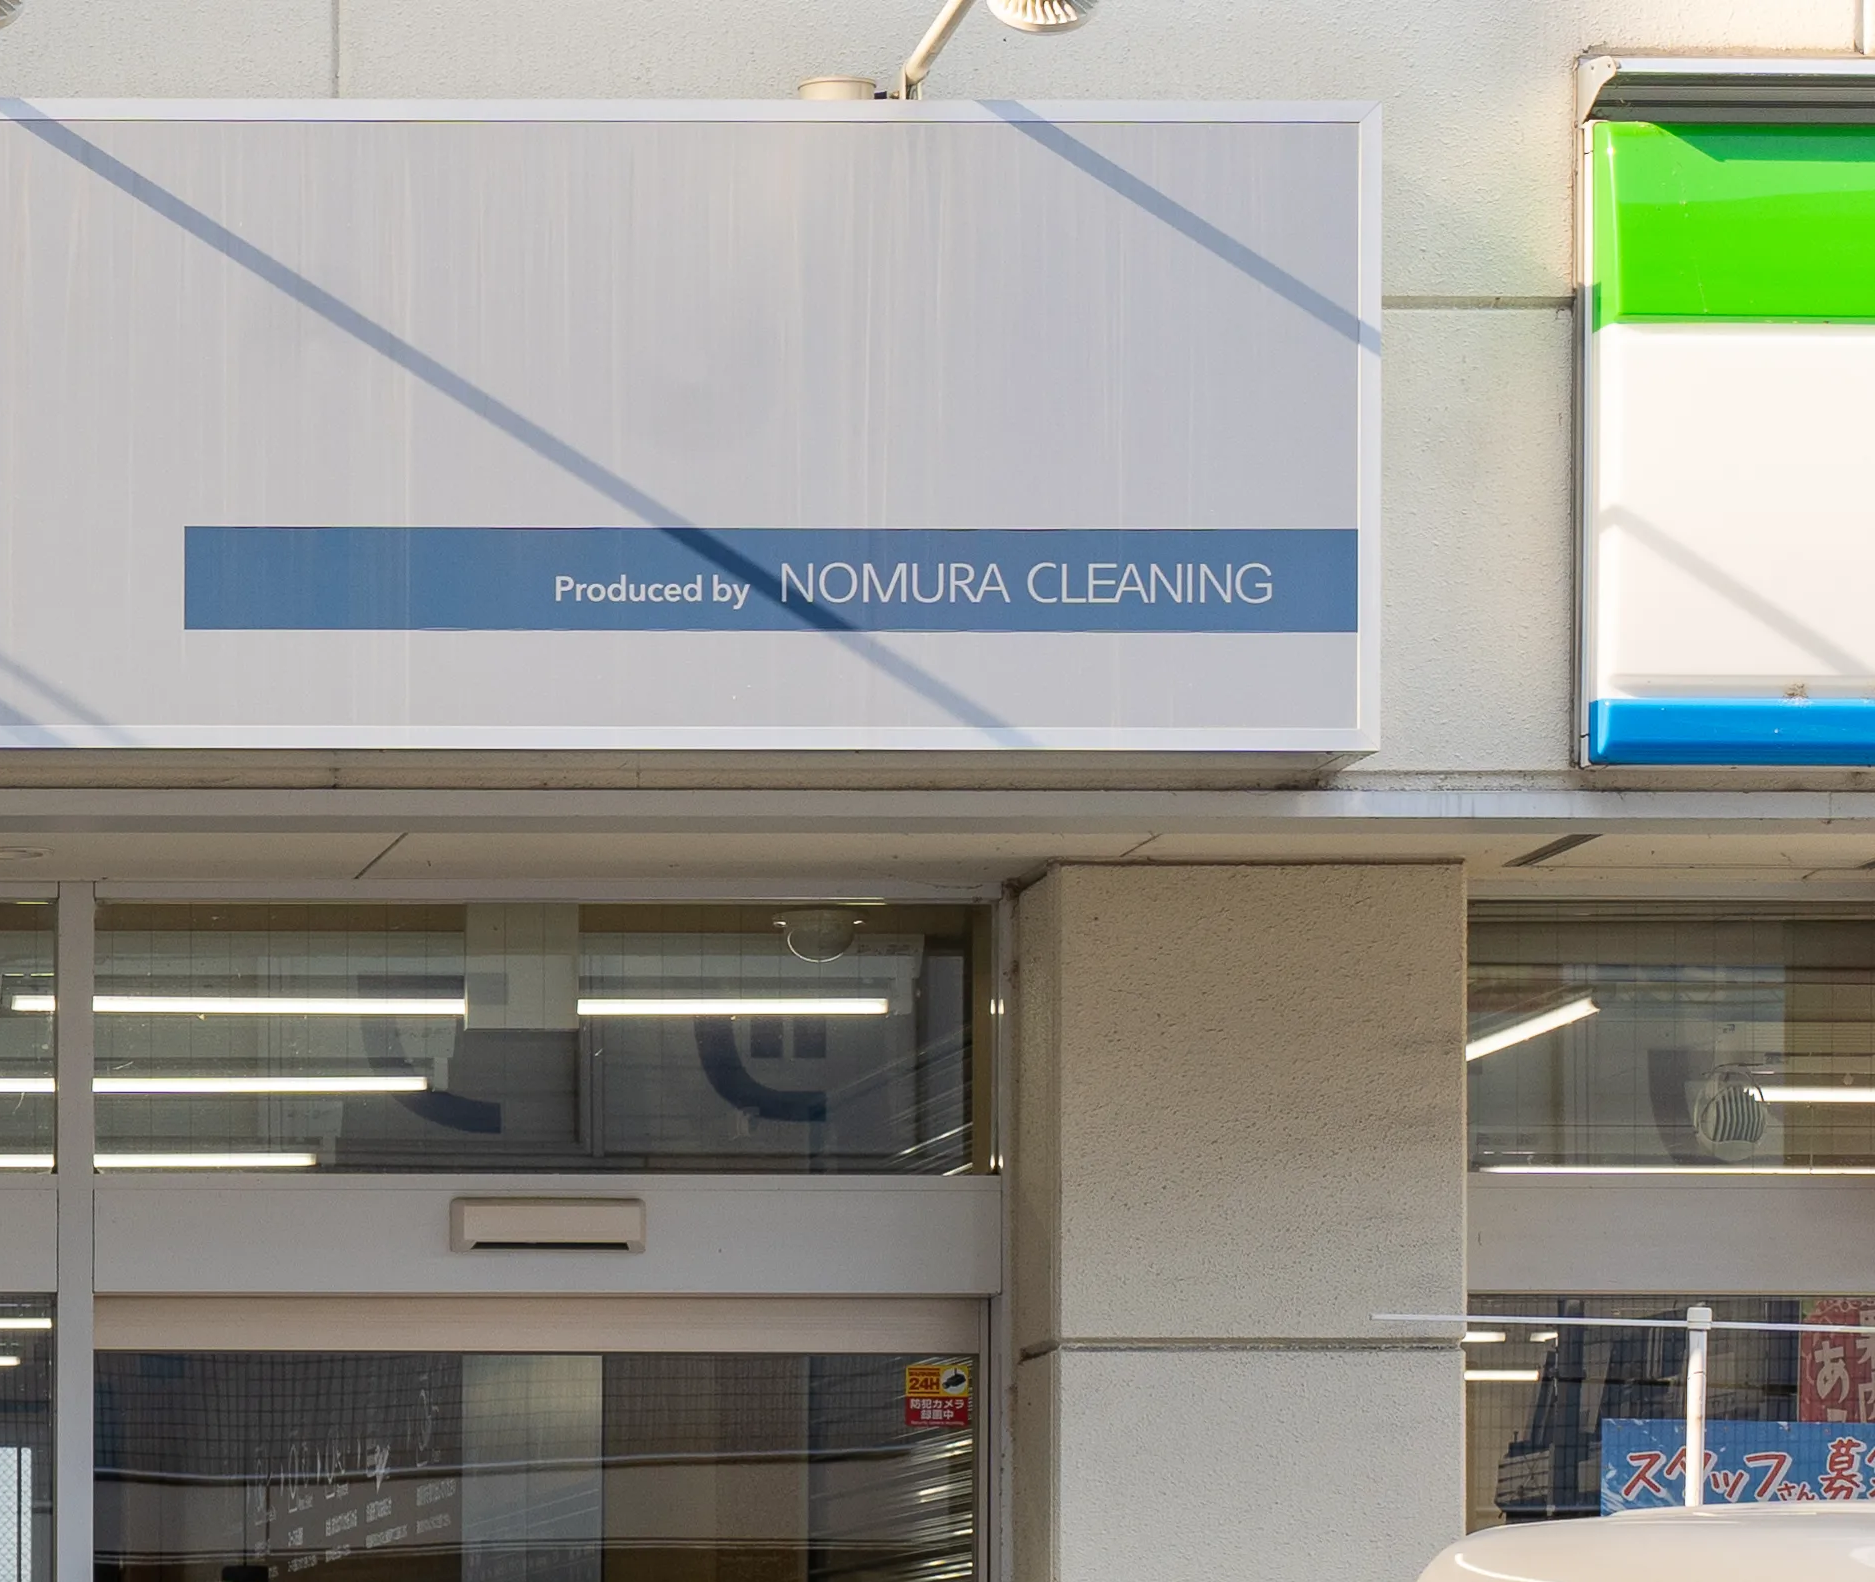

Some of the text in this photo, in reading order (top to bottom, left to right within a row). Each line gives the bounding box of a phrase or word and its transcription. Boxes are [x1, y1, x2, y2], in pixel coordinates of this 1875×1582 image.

[553, 561, 1276, 610] Produced by NOMURA CLEANING
[909, 1377, 940, 1391] 24H
[909, 1399, 965, 1409] 防犯カメラ
[920, 1409, 954, 1420] 録画中
